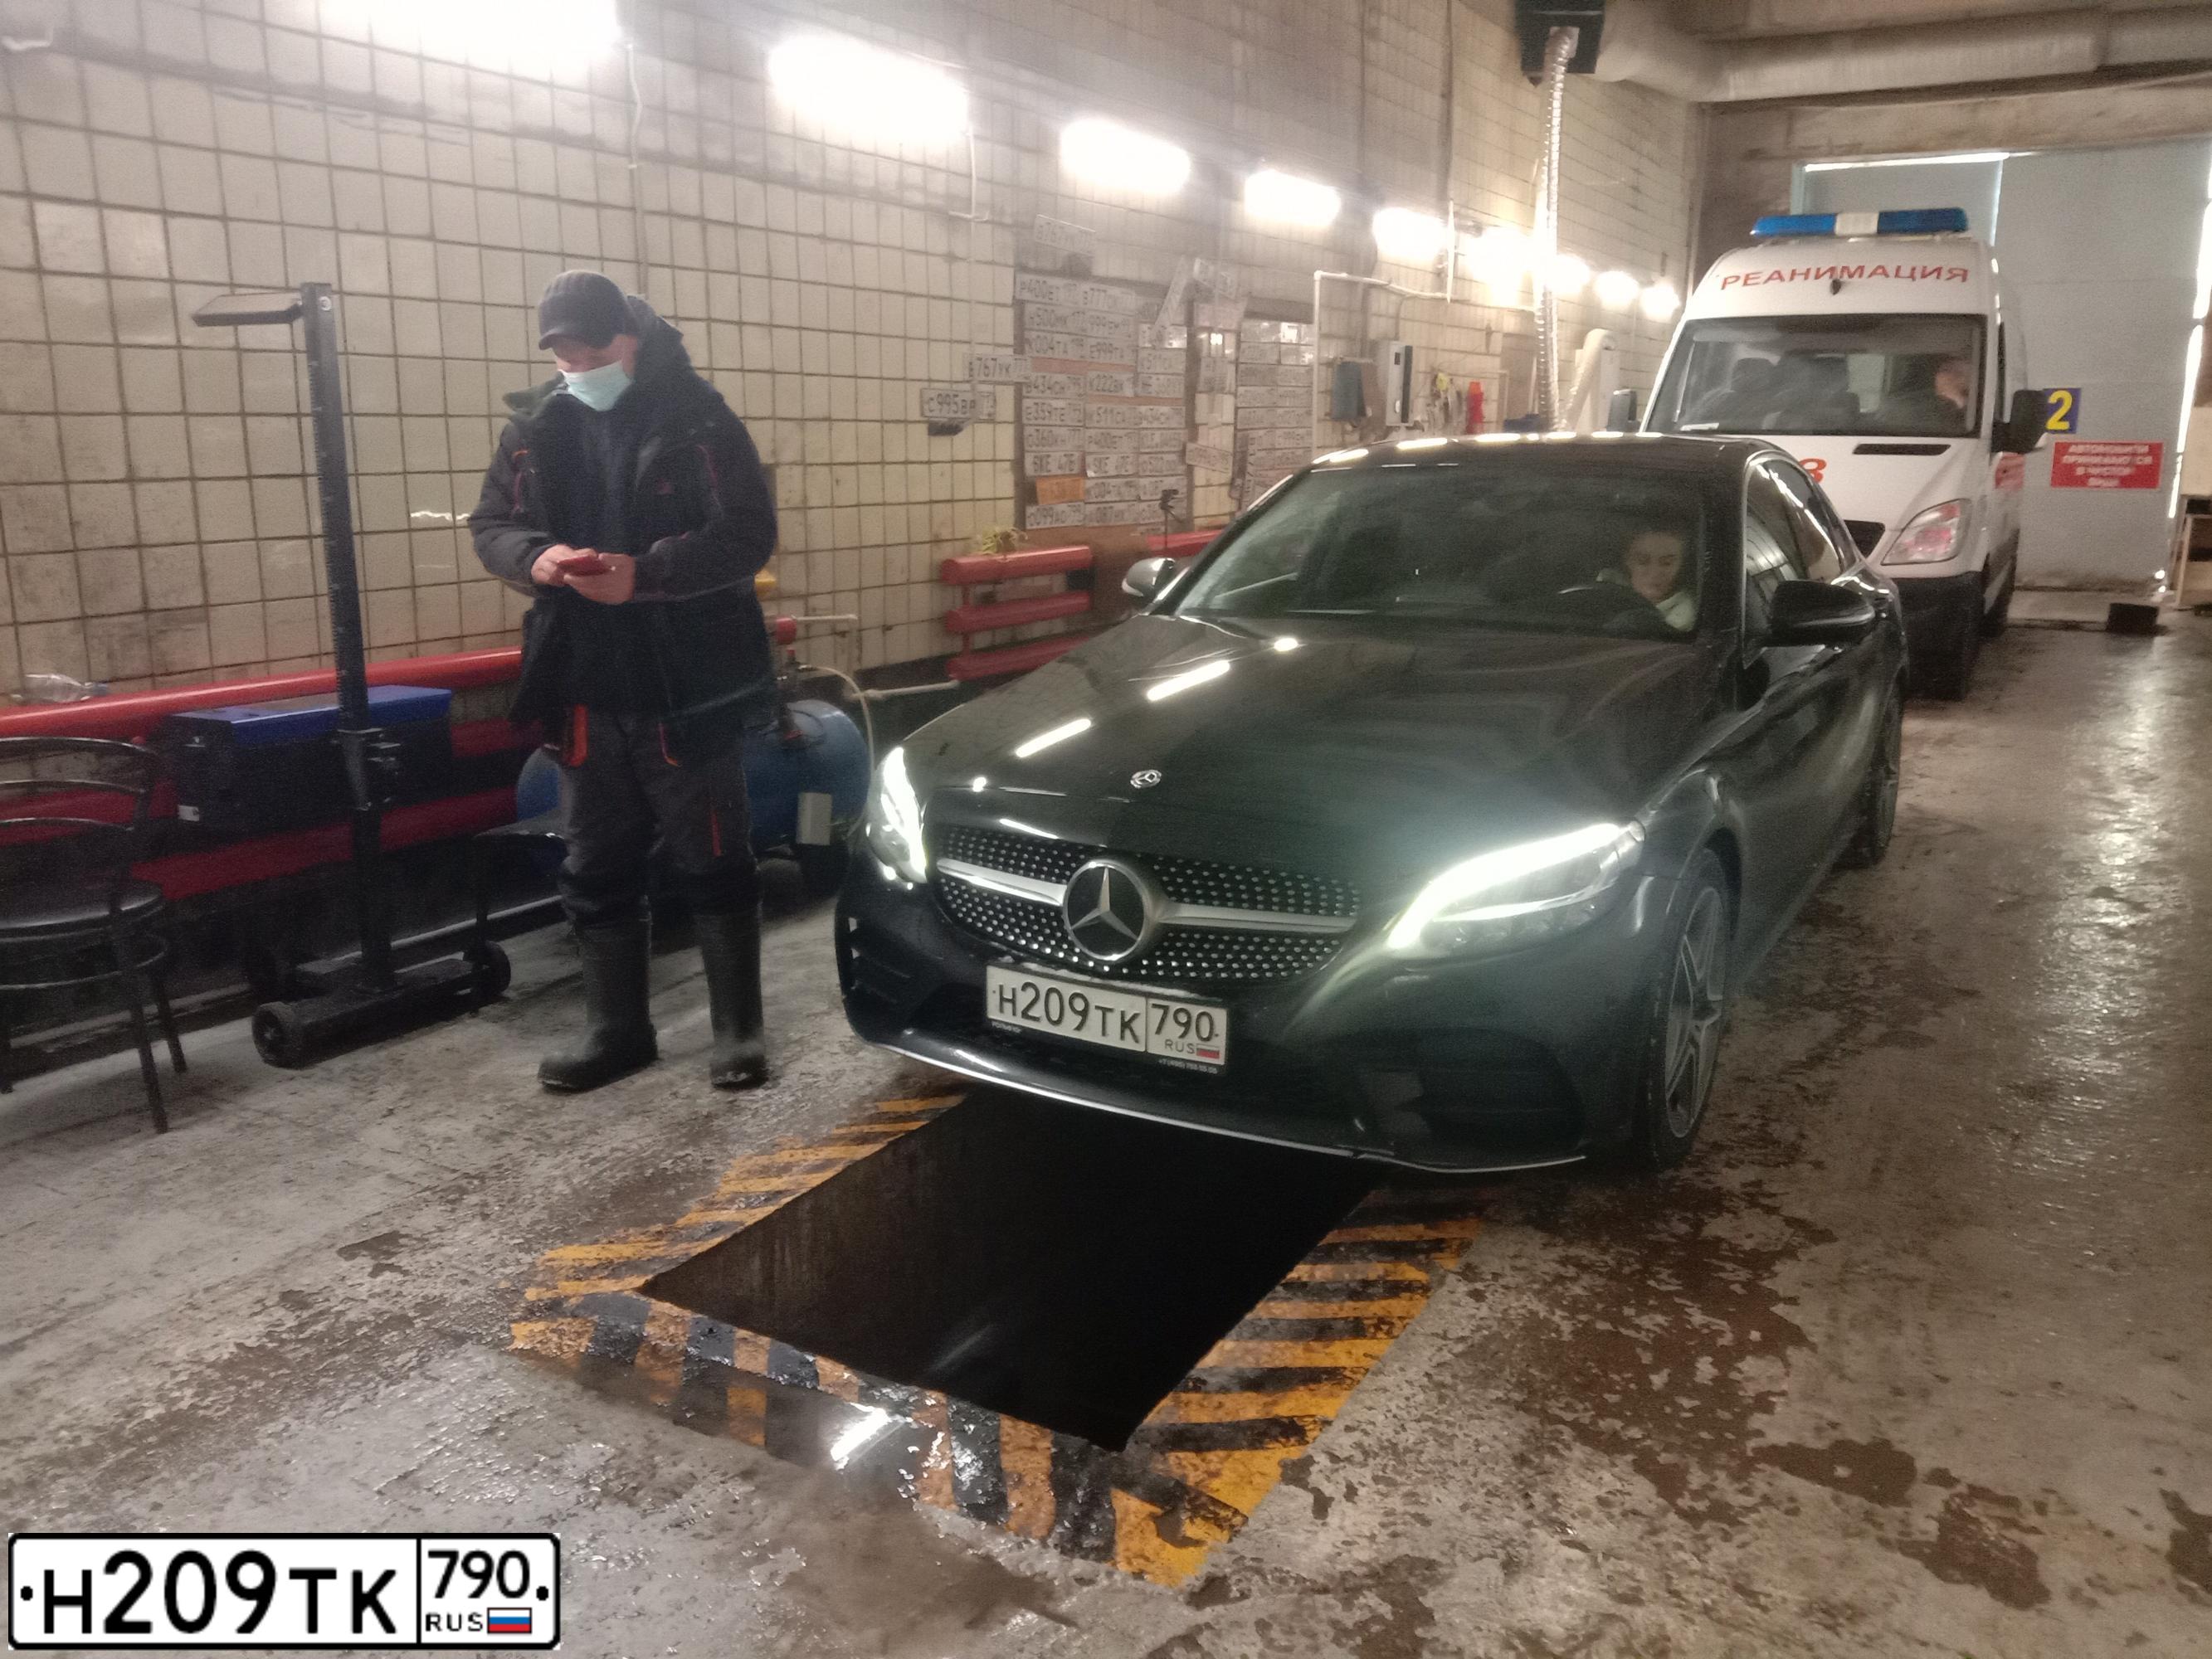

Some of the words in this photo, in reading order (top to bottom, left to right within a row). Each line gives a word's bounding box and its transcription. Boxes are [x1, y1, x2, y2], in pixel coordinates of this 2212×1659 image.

[1721, 264, 1969, 290] РЕАНИМАЦИЯ
[2045, 389, 2073, 431] 2
[998, 980, 1142, 1044] Н209ТК
[1150, 1002, 1216, 1043] 790
[1164, 1039, 1195, 1054] RUS
